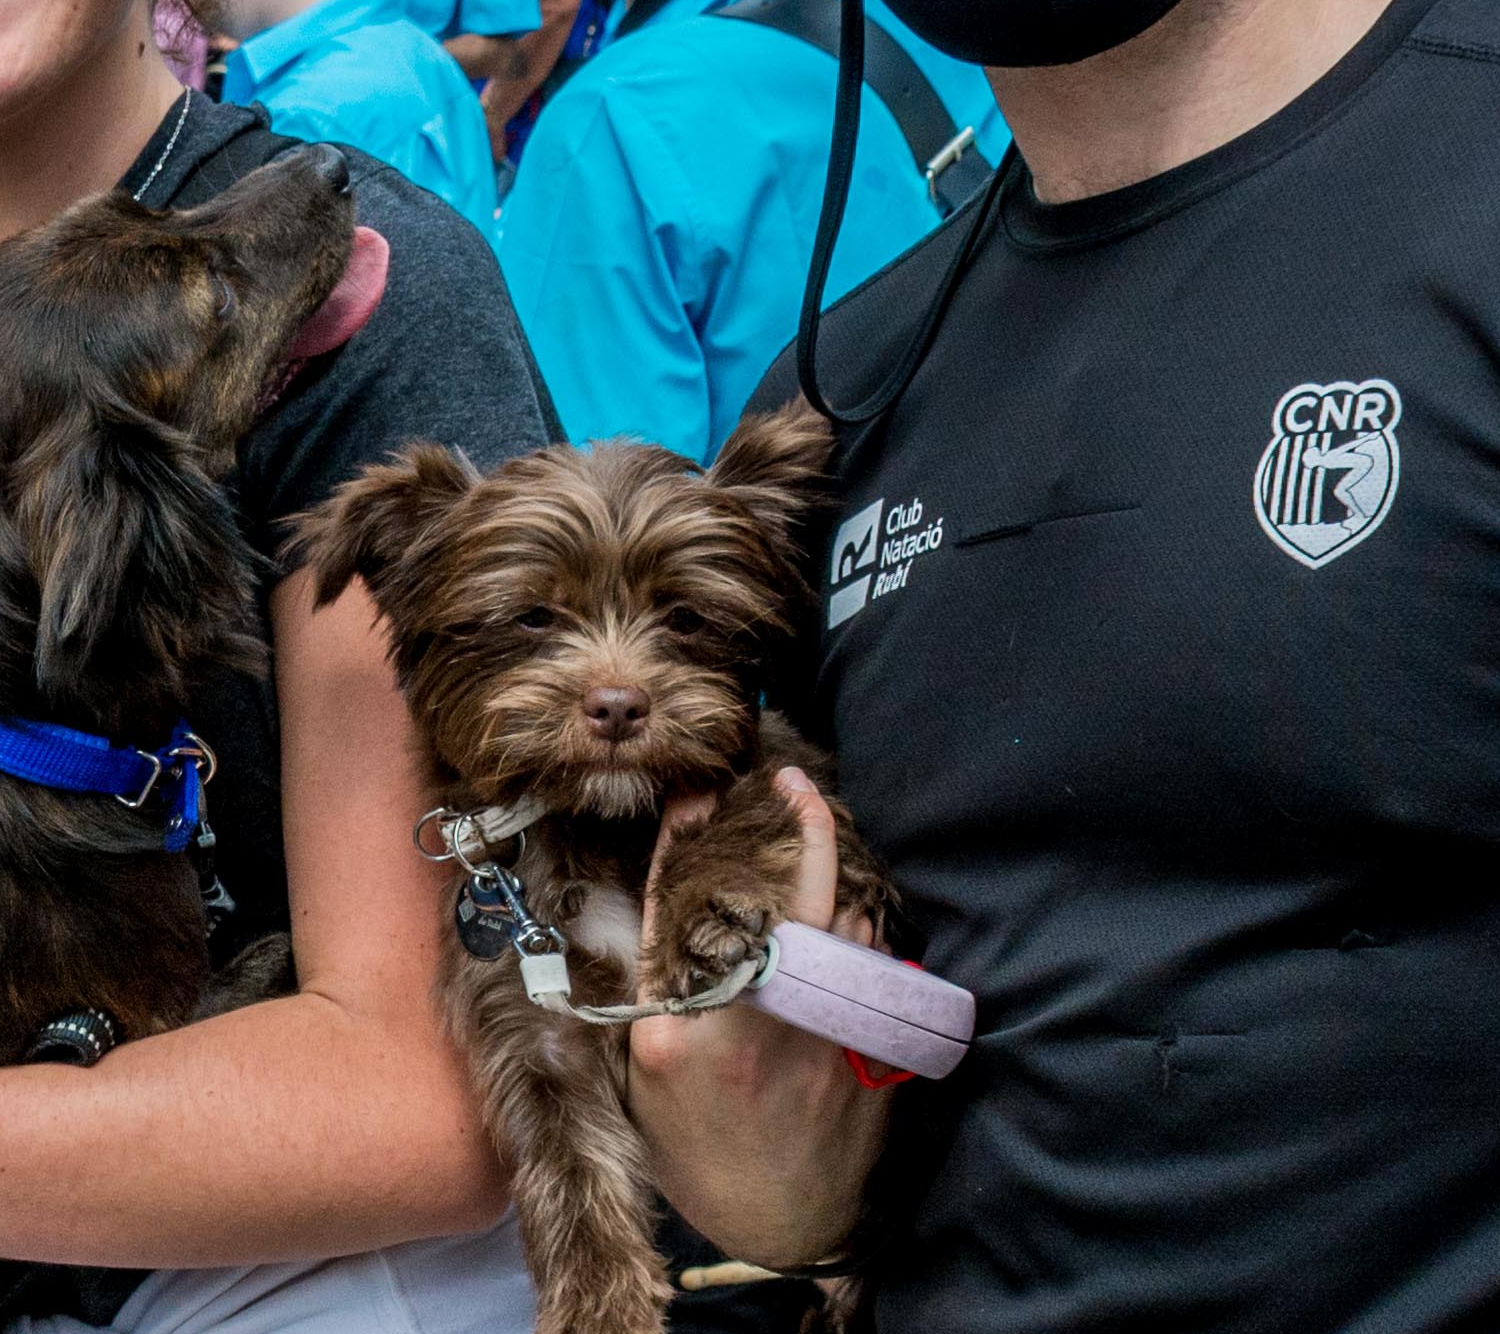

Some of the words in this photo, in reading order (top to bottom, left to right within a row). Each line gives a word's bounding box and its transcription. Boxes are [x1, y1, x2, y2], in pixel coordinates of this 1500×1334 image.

[1285, 392, 1386, 433] CNR
[885, 497, 924, 536] Club
[880, 517, 944, 569] Natació
[871, 558, 914, 600] Rubí
